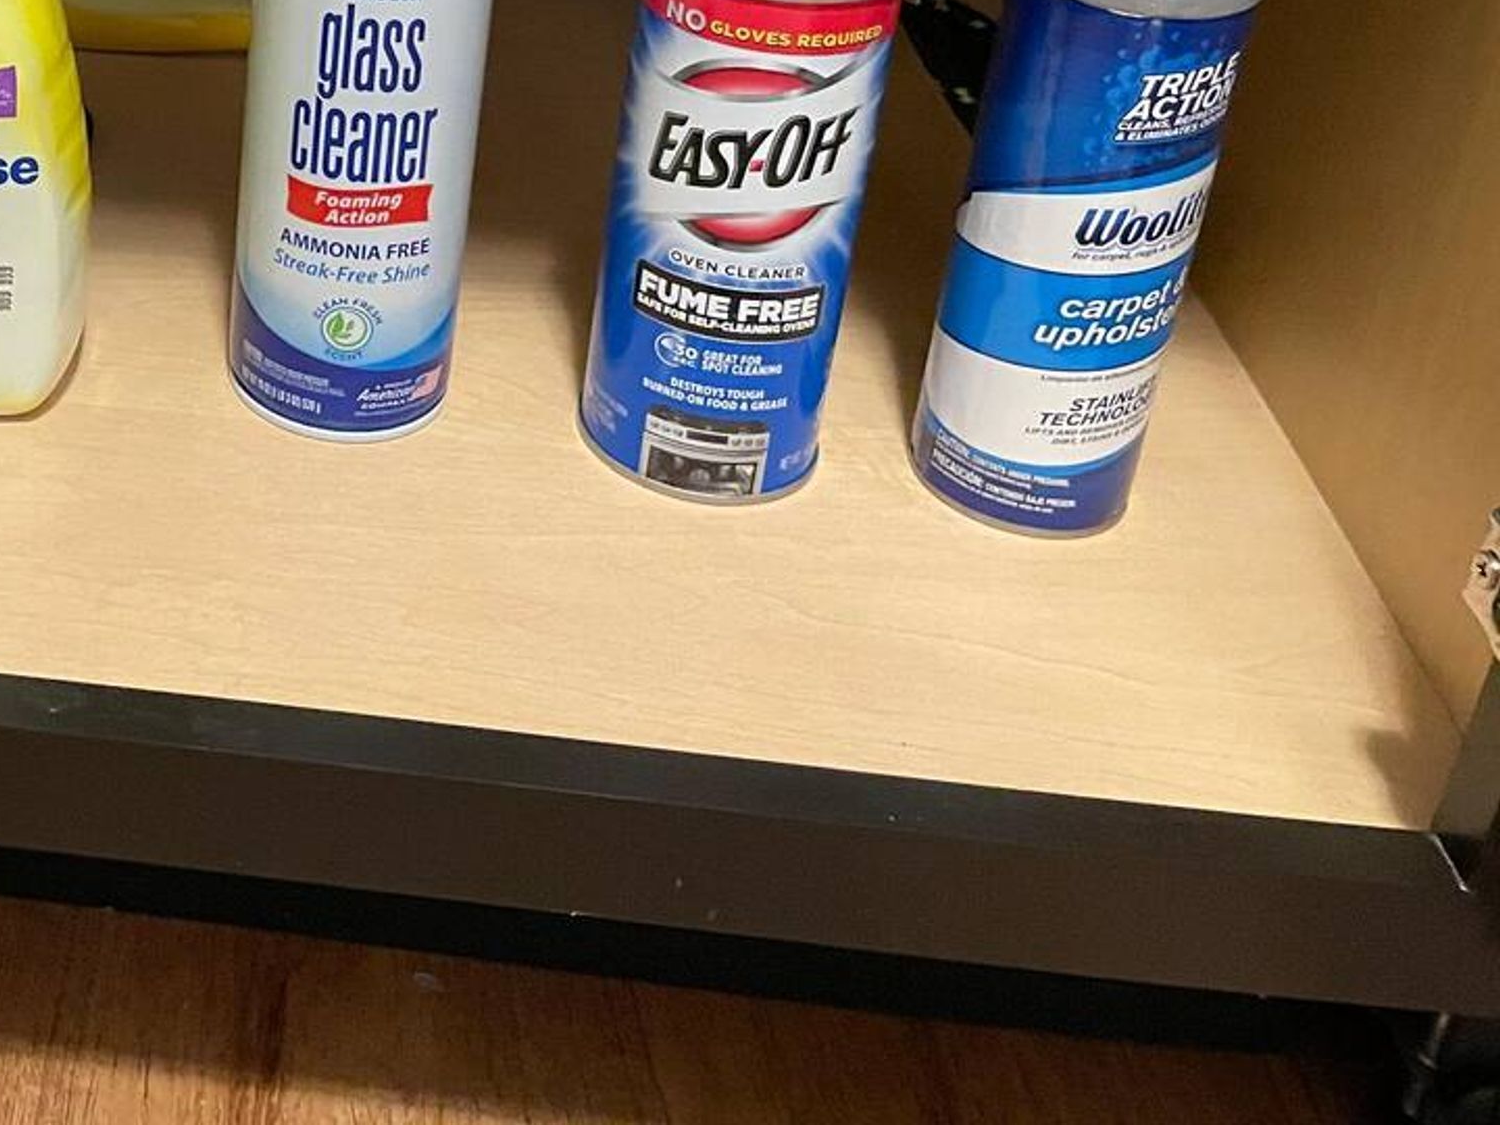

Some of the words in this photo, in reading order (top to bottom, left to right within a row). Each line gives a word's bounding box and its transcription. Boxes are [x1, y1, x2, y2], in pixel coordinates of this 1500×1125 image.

[316, 3, 427, 100] glass
[709, 20, 792, 48] GLOVES
[797, 24, 884, 49] REQUIRED
[1141, 51, 1241, 97] TRIPLE
[290, 96, 439, 184] cleaner
[313, 190, 403, 210] Foaming
[324, 209, 391, 225] Action
[280, 227, 382, 261] AMMONIA
[386, 237, 431, 260] FREE
[273, 247, 379, 284] Streak-Free
[381, 262, 432, 285] Shine
[670, 249, 719, 274] OVEN
[724, 263, 806, 279] CLEANER
[639, 267, 732, 321] FUME
[737, 292, 821, 323] FREE
[1059, 279, 1172, 323] carpet
[636, 291, 663, 312] SAFE
[663, 305, 688, 321] FOR
[687, 312, 781, 335] SELF-CLEANING
[782, 317, 816, 333] OVENS
[674, 344, 699, 360] 30
[701, 359, 730, 375] SPOT
[731, 362, 783, 376] CLEANING
[702, 349, 739, 365] GREAT
[739, 354, 763, 366] FOR
[642, 376, 706, 407] BURNED-ON
[706, 398, 738, 412] FOOD
[739, 401, 749, 412] &
[750, 396, 789, 412] GREASE
[670, 376, 726, 399] DESTROYS
[727, 388, 765, 401] TOUGH
